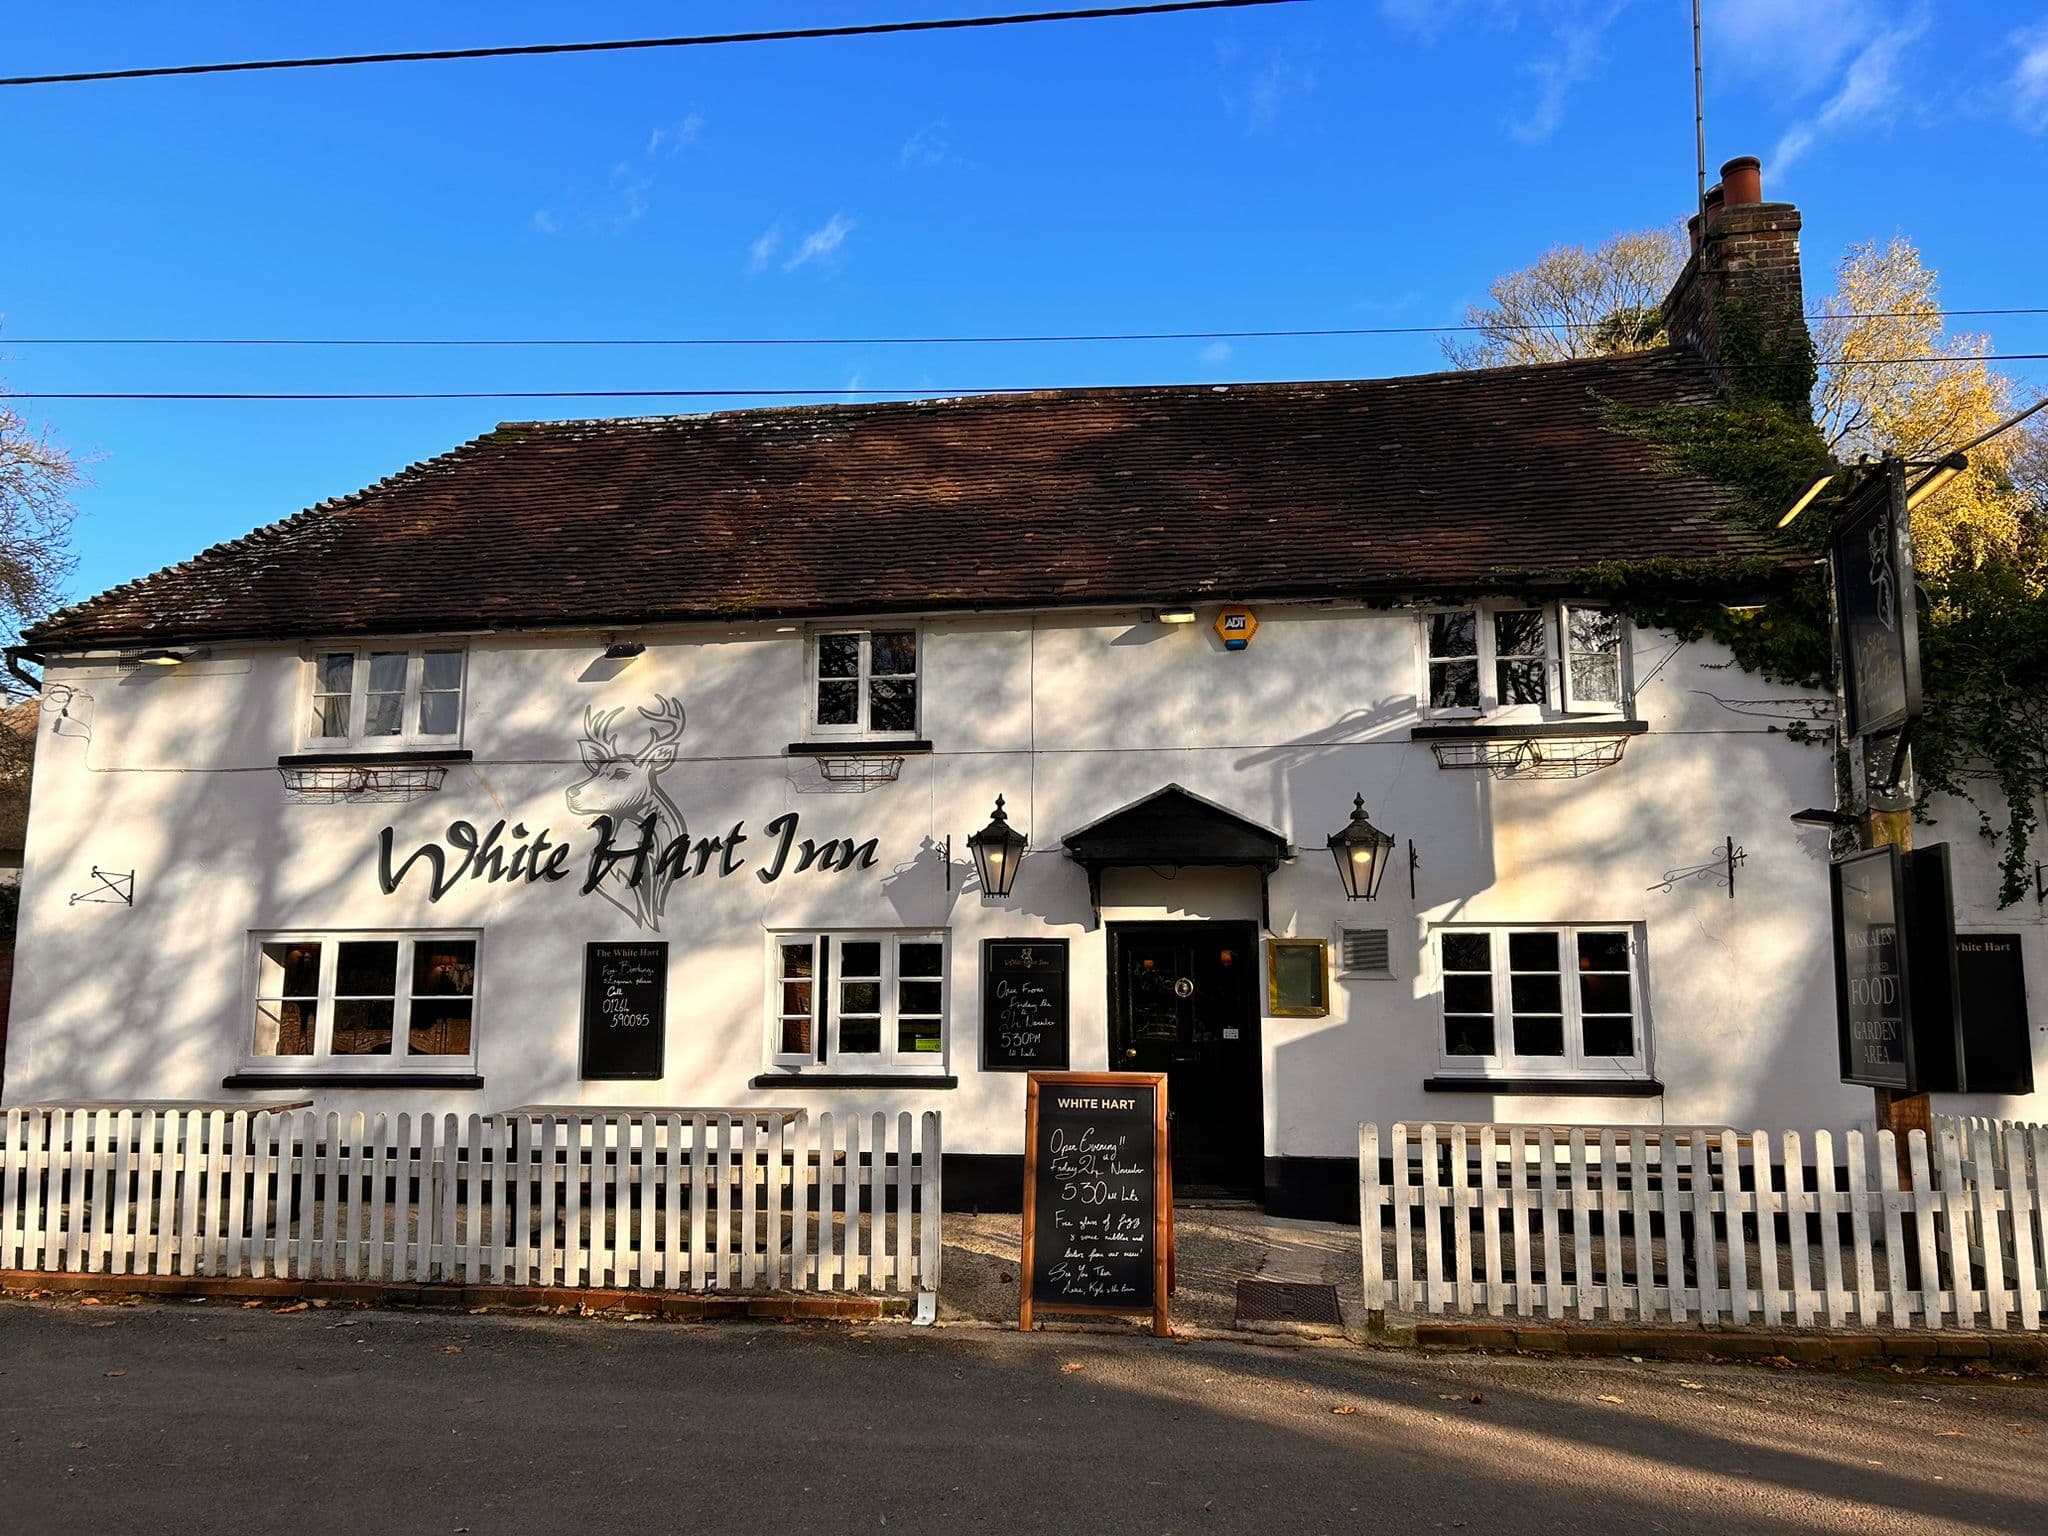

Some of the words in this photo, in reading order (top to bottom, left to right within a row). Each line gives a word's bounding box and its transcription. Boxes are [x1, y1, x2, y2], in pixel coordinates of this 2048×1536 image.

[1225, 617, 1245, 628] ADT
[378, 819, 570, 903] White
[579, 812, 747, 897] Hart
[756, 812, 879, 884] Inn
[1870, 928, 1892, 946] ALES
[596, 948, 612, 957] The
[613, 948, 639, 957] White
[640, 948, 660, 957] Hart
[1985, 942, 2011, 952] Hart
[606, 986, 623, 997] Call
[996, 980, 1017, 999] Open
[1851, 976, 1895, 1005] FOOD
[602, 998, 630, 1014] 01264
[610, 1013, 650, 1028] 590085
[1854, 1021, 1897, 1041] GARDEN
[1864, 1045, 1890, 1065] AREA
[1057, 1098, 1099, 1109] WHITE
[1101, 1099, 1136, 1110] HART
[1050, 1128, 1077, 1157] Open
[1102, 1213, 1111, 1232] of
